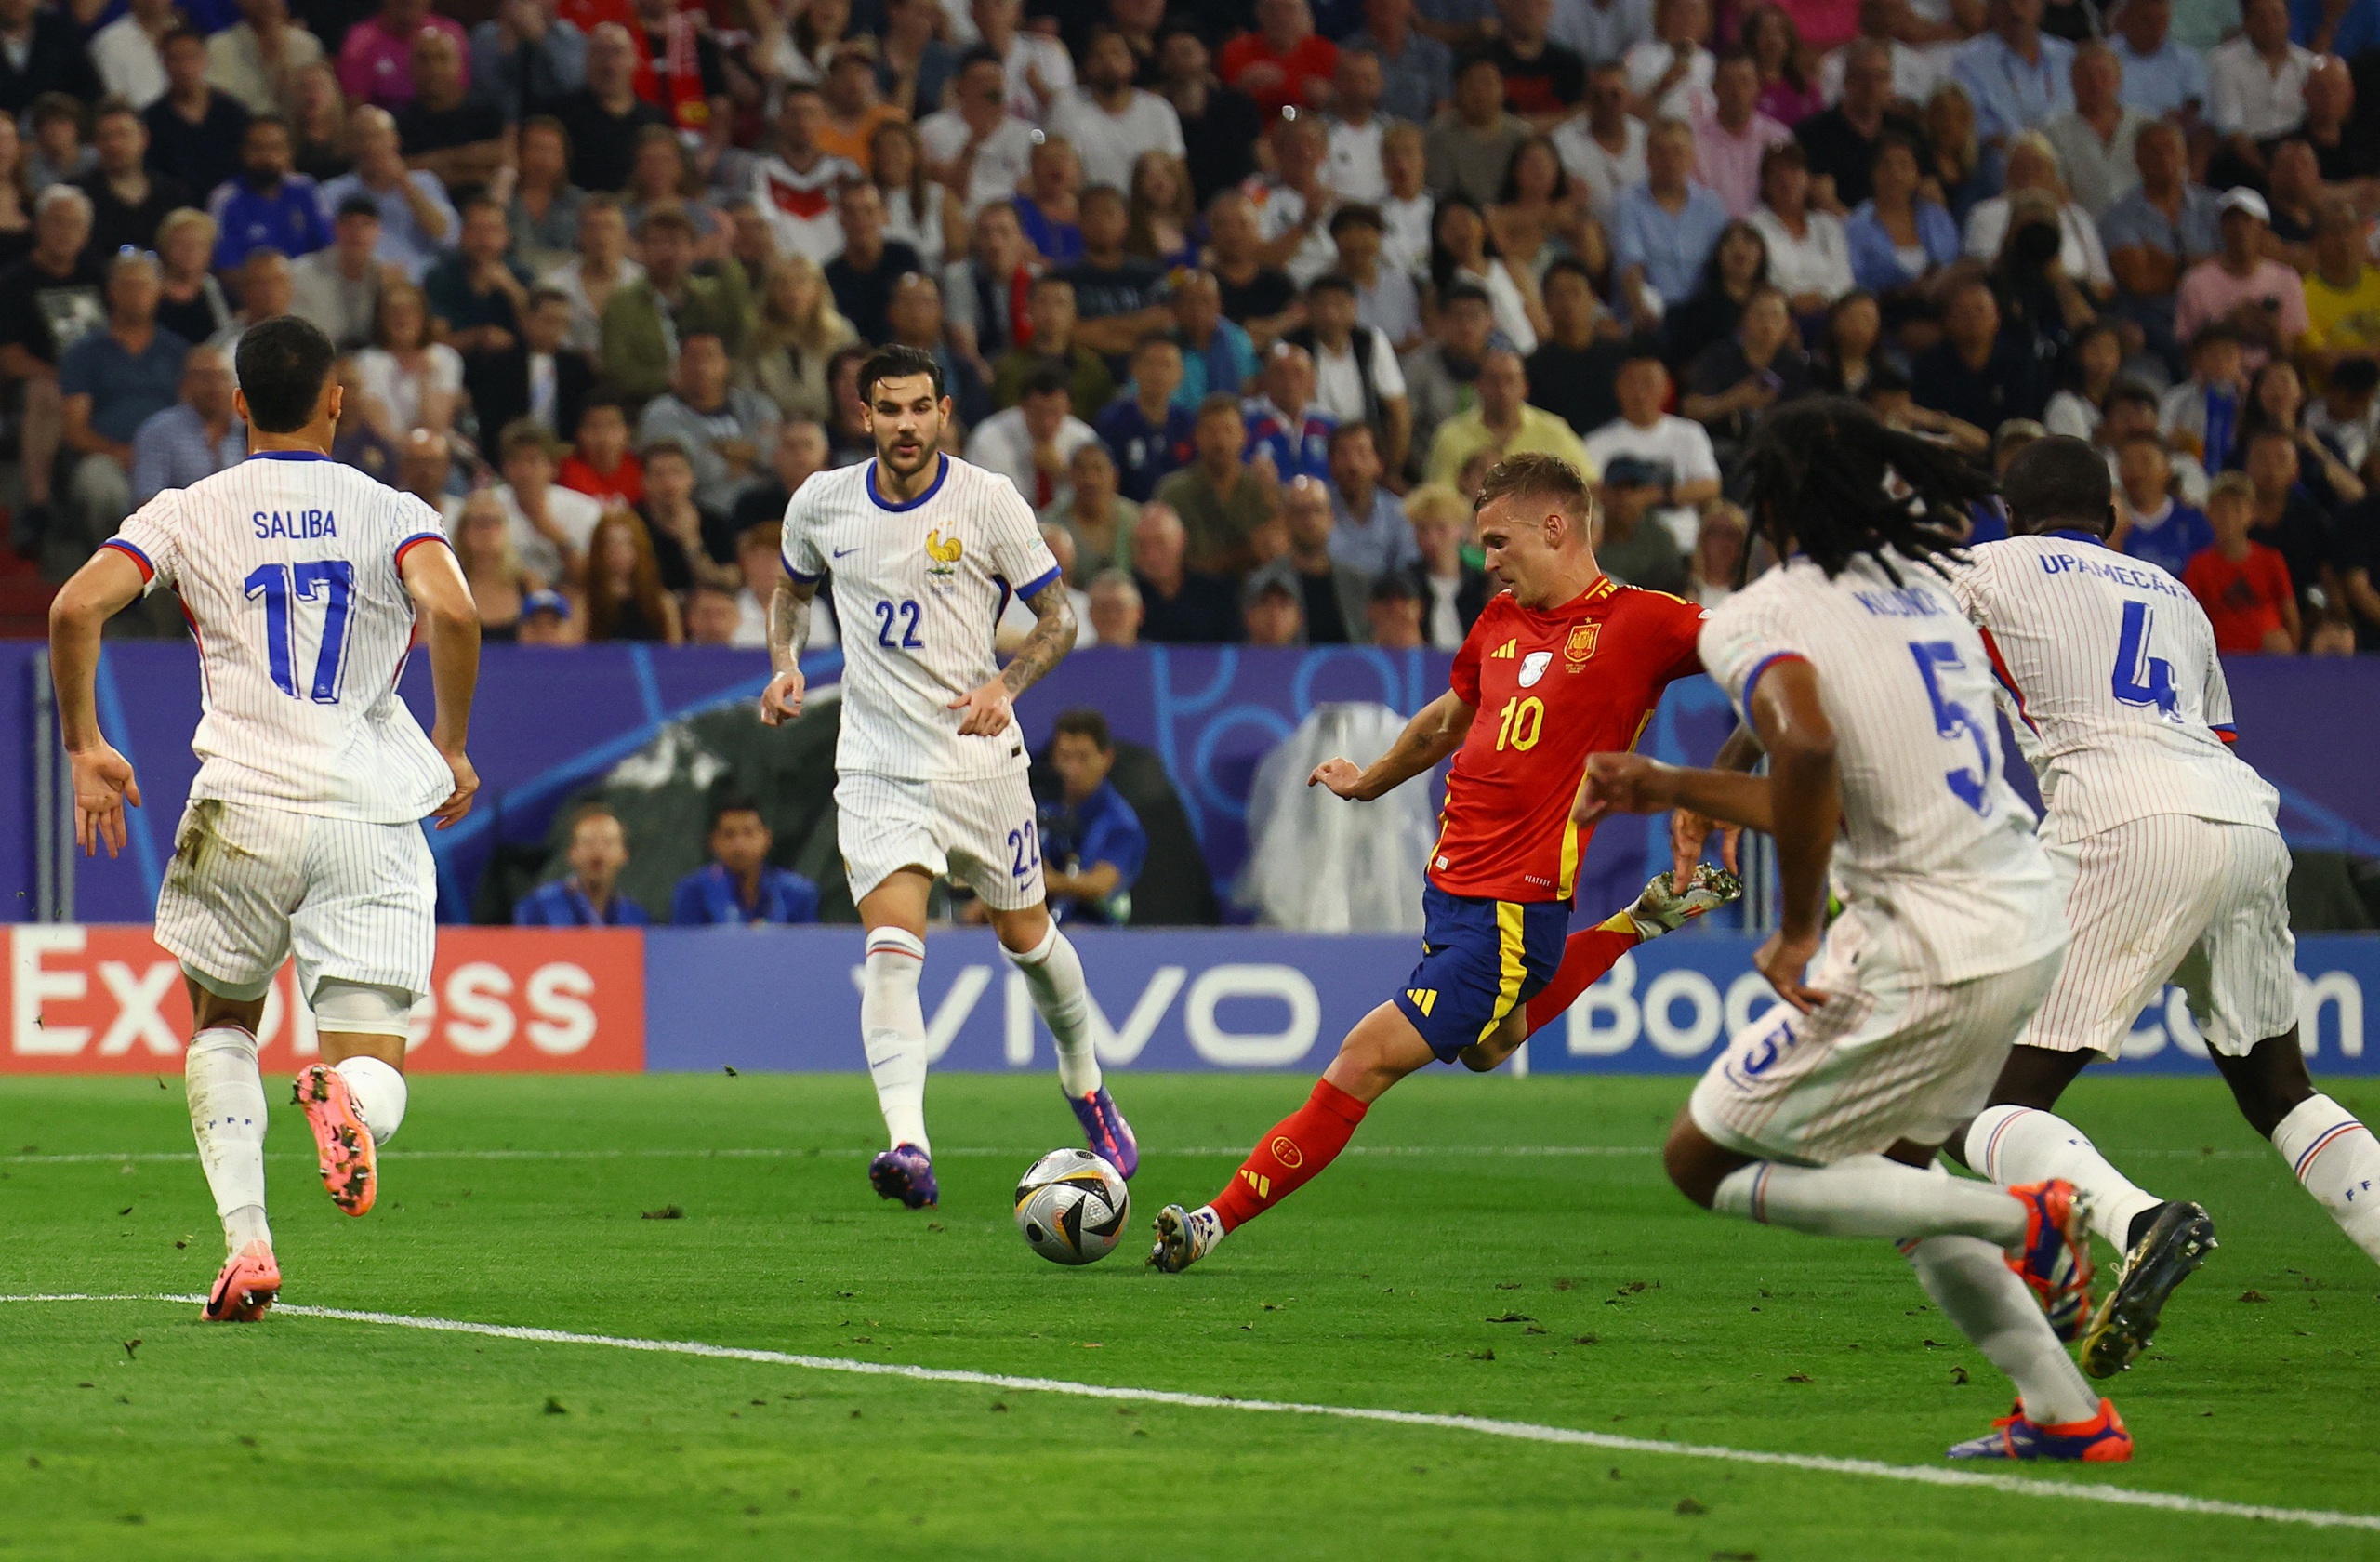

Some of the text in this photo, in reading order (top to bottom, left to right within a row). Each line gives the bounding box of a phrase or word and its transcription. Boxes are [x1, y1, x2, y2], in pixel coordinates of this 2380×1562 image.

[253, 510, 337, 538] SALIBA
[245, 560, 357, 704] 17
[876, 600, 925, 649] 22
[2112, 600, 2184, 723] 4
[1496, 696, 1545, 751] 10
[1909, 641, 1995, 818] 5
[1008, 819, 1038, 878] 22
[11, 924, 598, 1055] Exss
[1744, 1019, 1796, 1075] 5
